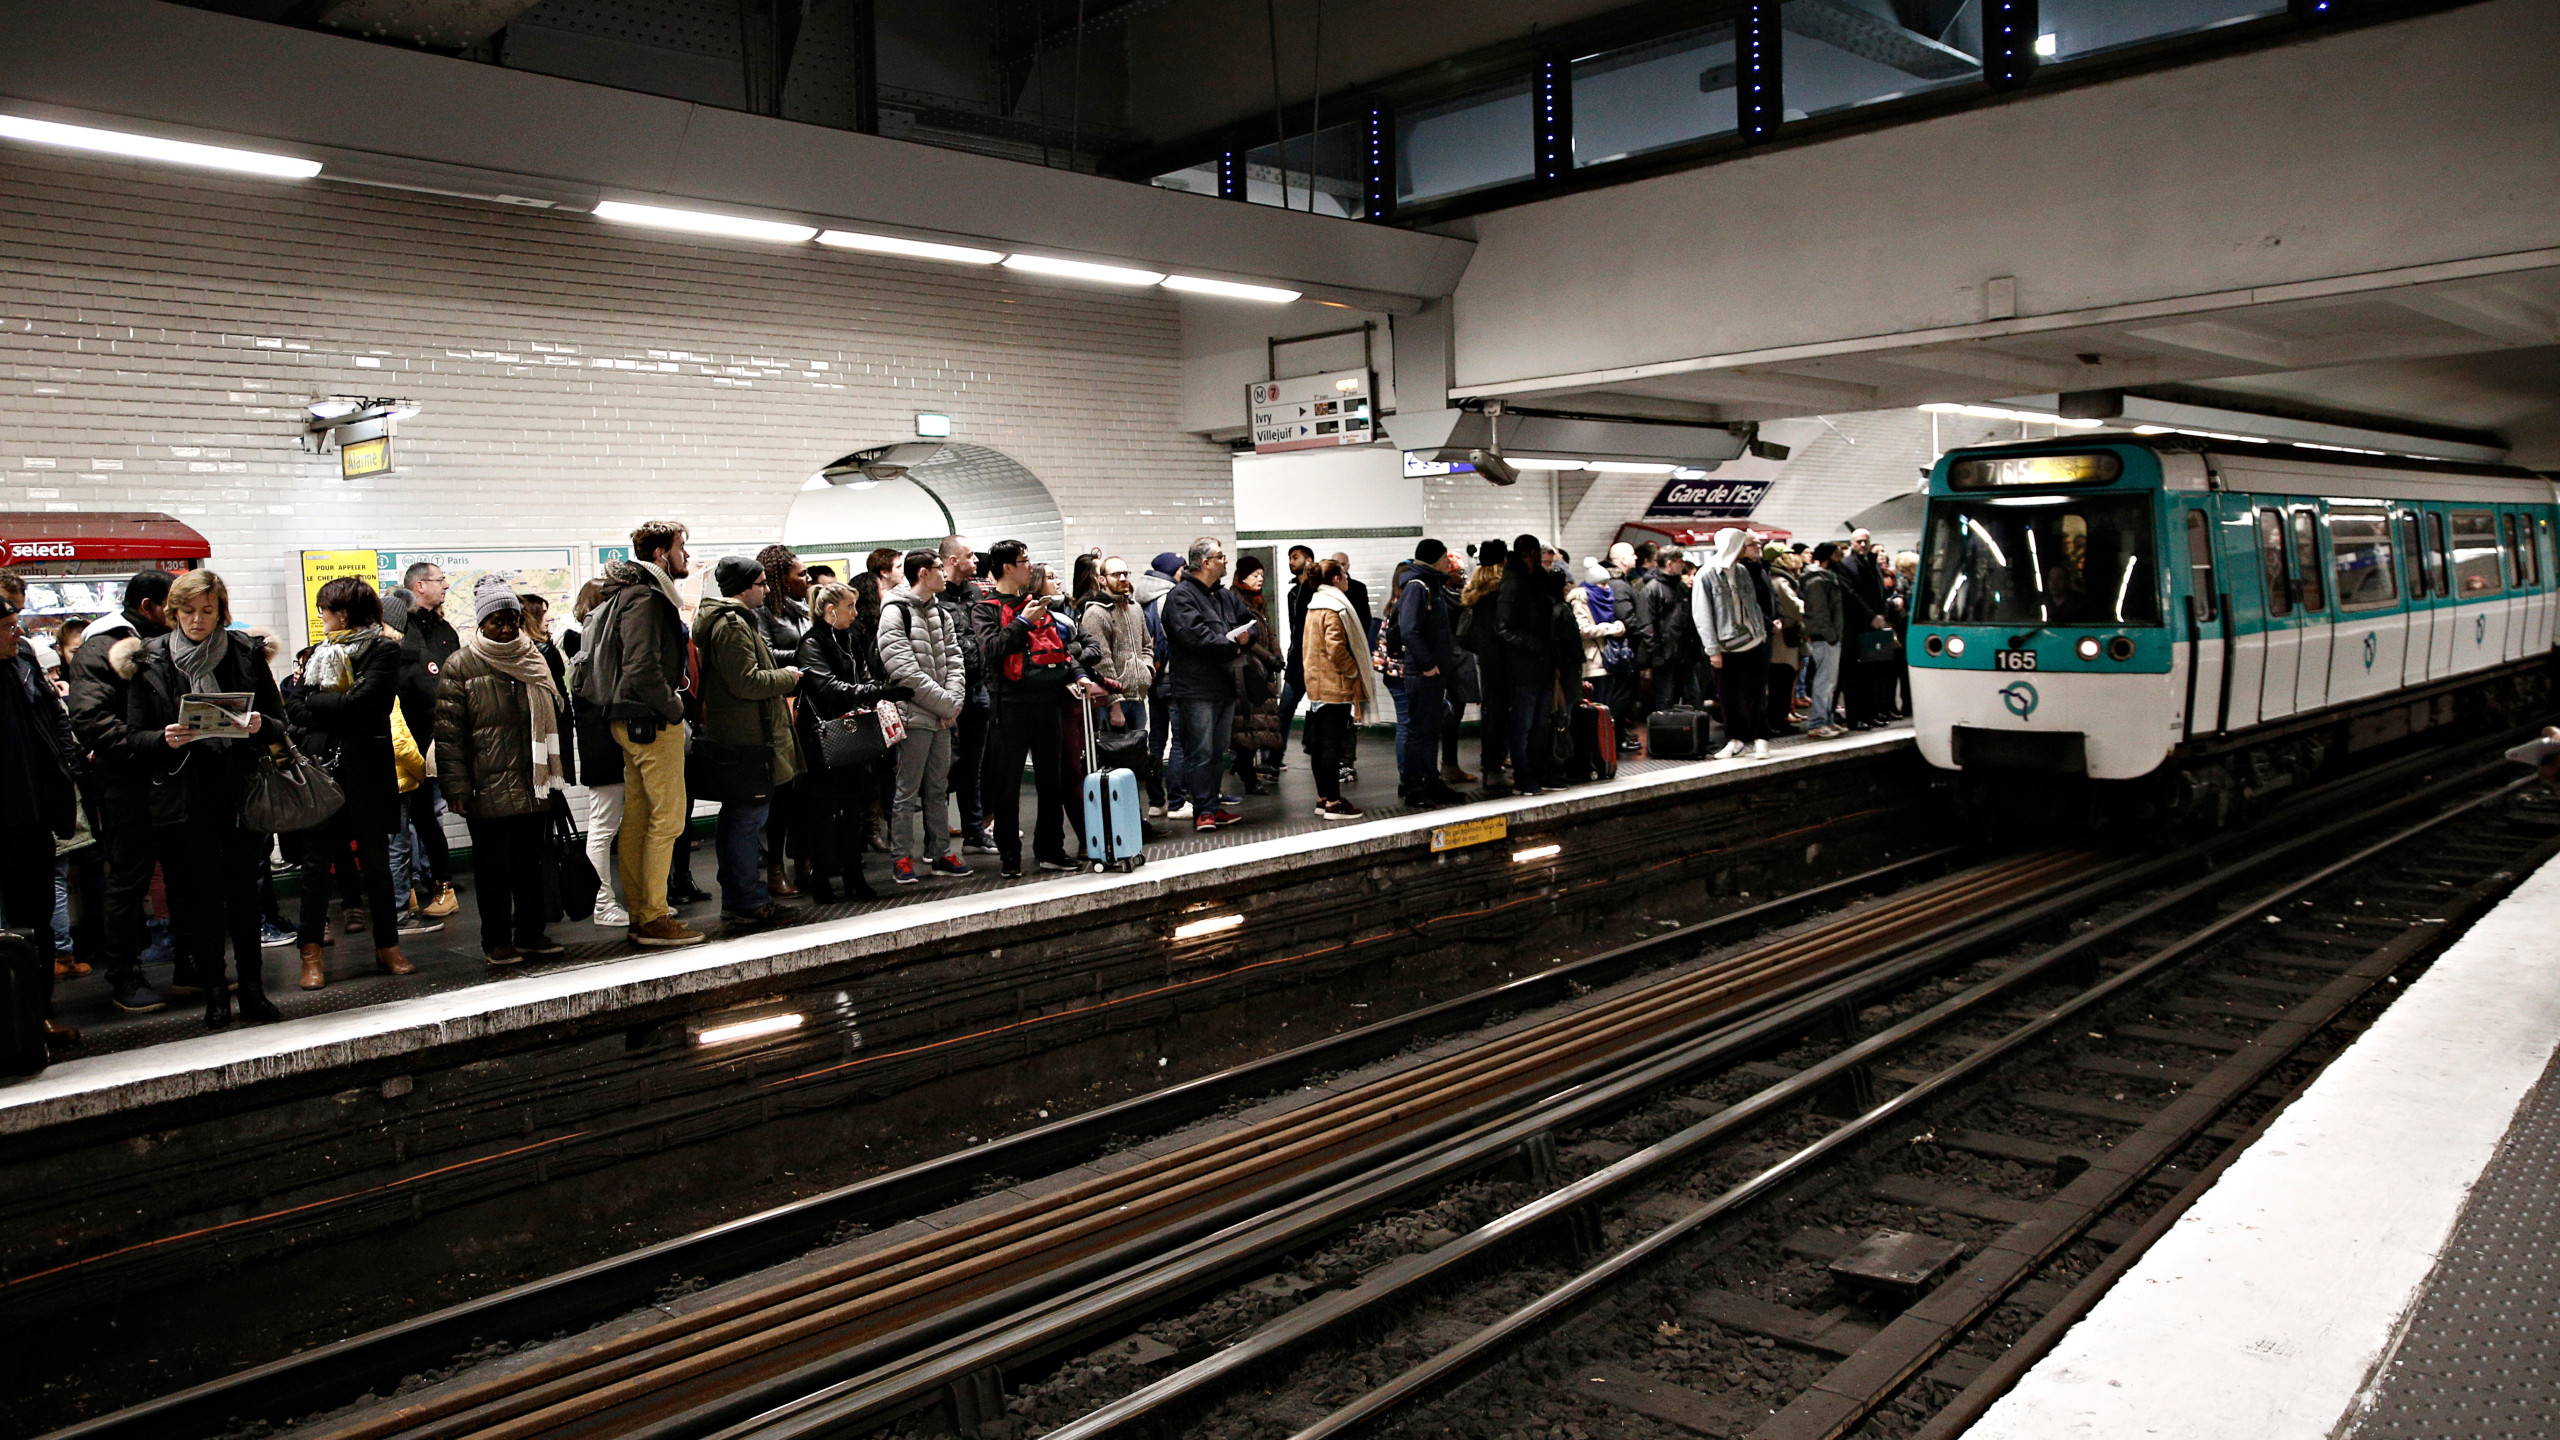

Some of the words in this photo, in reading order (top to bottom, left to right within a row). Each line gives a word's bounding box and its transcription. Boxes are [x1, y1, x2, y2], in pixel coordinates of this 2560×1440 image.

[1255, 412, 1272, 425] Ivry
[1257, 427, 1293, 442] Villejuif
[348, 452, 377, 470] Alarme
[1667, 483, 1707, 503] Gare
[1705, 484, 1728, 503] de
[1725, 484, 1762, 503] l'Est
[12, 543, 75, 557] selecta
[448, 556, 469, 565] Paris
[1997, 651, 2036, 670] 165
